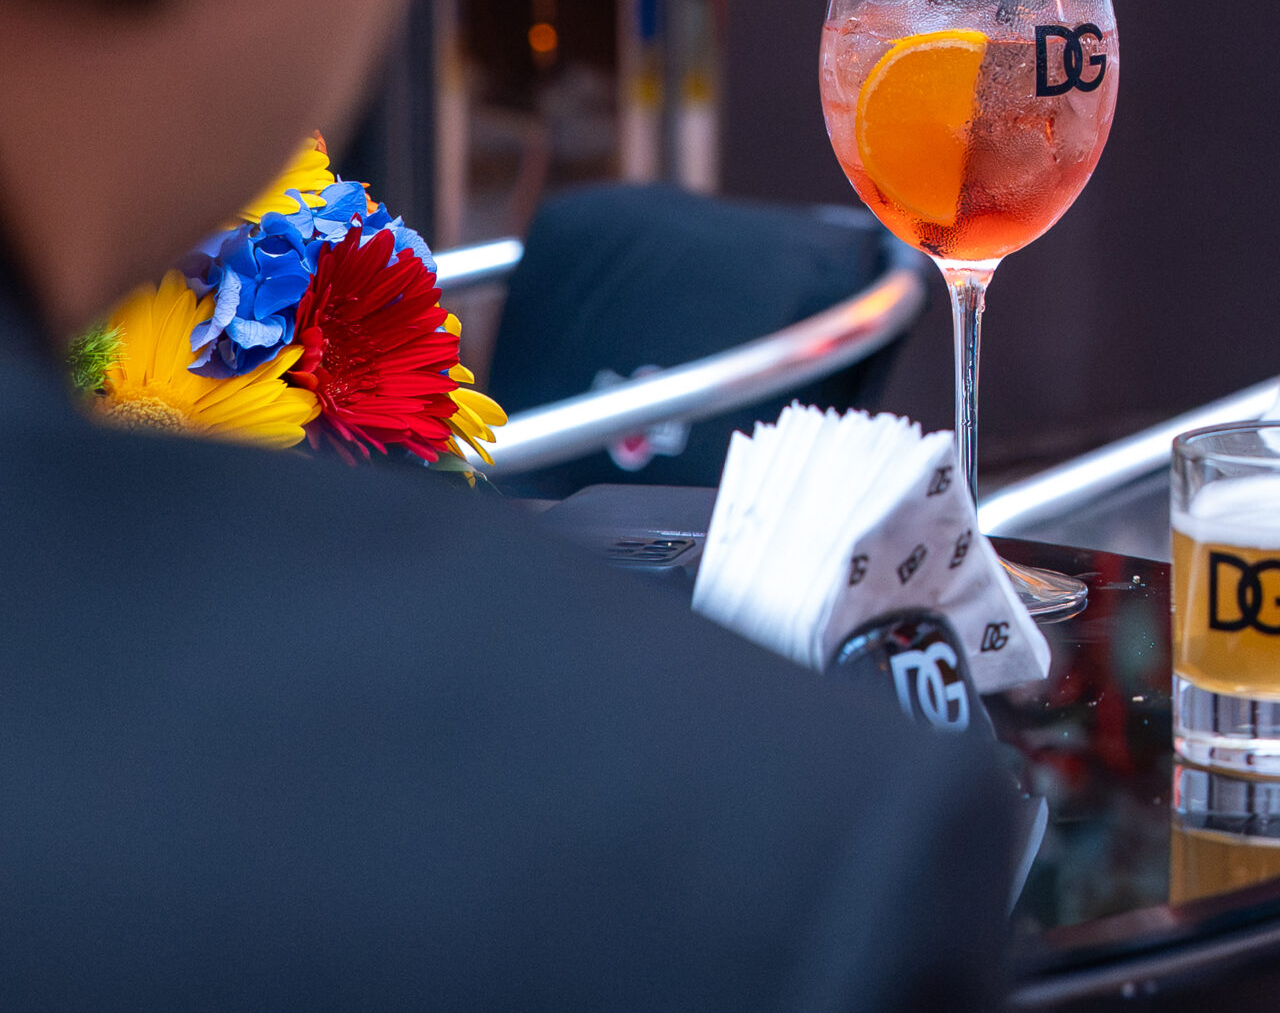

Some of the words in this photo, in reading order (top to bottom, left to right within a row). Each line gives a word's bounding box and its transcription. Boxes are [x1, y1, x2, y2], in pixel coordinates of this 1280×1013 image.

[1035, 23, 1107, 97] DG
[980, 621, 1010, 653] DG
[890, 641, 970, 732] DG
